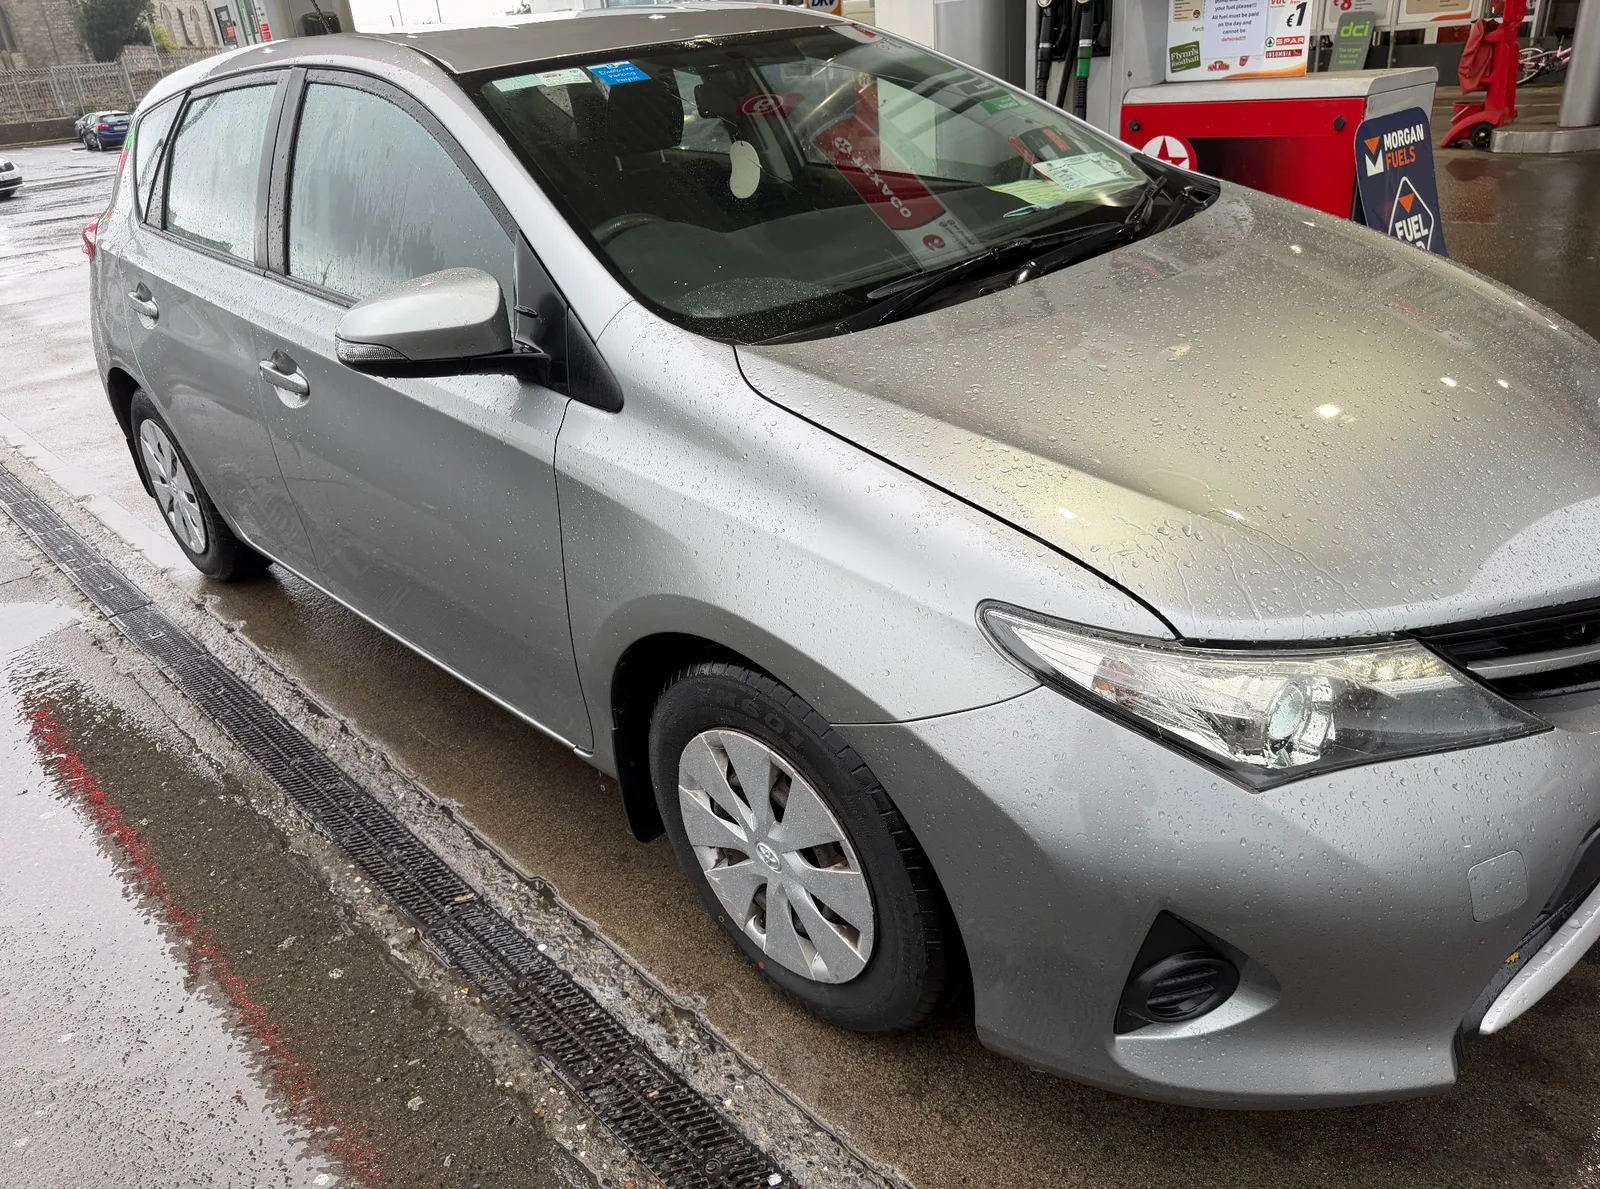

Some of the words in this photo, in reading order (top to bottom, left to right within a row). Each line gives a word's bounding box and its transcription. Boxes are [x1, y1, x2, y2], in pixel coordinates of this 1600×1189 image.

[1340, 21, 1371, 38] dci
[1277, 37, 1304, 45] SPAR
[1171, 48, 1199, 61] Flynn's
[1171, 55, 1199, 67] foodhall
[1383, 124, 1424, 151] MORGAN
[1386, 145, 1416, 171] FUELS
[1395, 213, 1428, 241] FUEL
